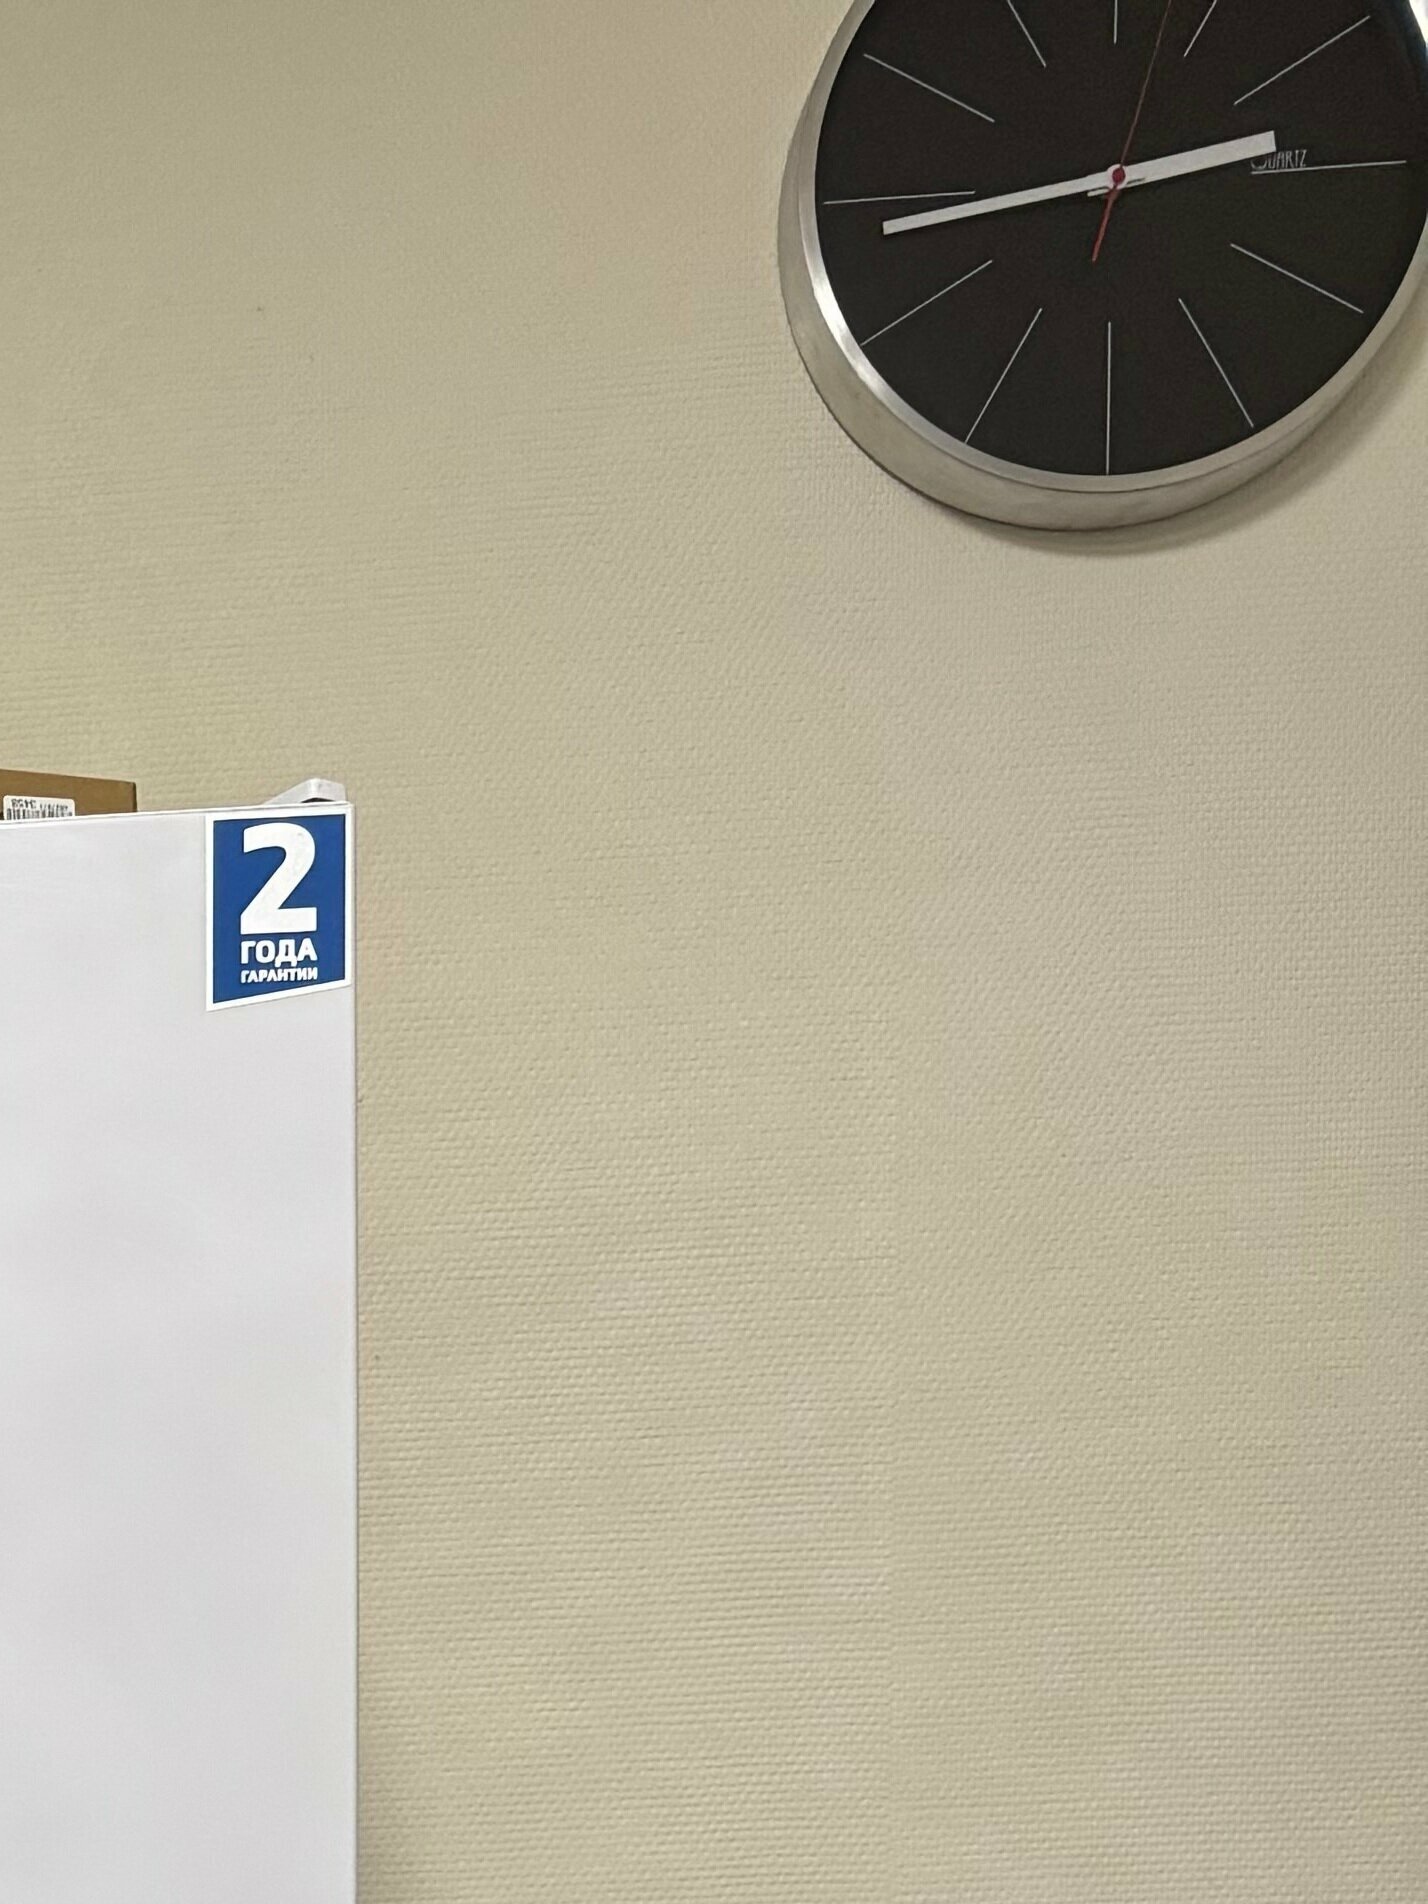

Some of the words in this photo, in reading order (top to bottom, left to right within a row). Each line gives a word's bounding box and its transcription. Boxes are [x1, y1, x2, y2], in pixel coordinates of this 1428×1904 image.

[240, 822, 318, 935] 2
[240, 938, 319, 968] ГОДА
[240, 966, 319, 984] ГАРАНТИИ
